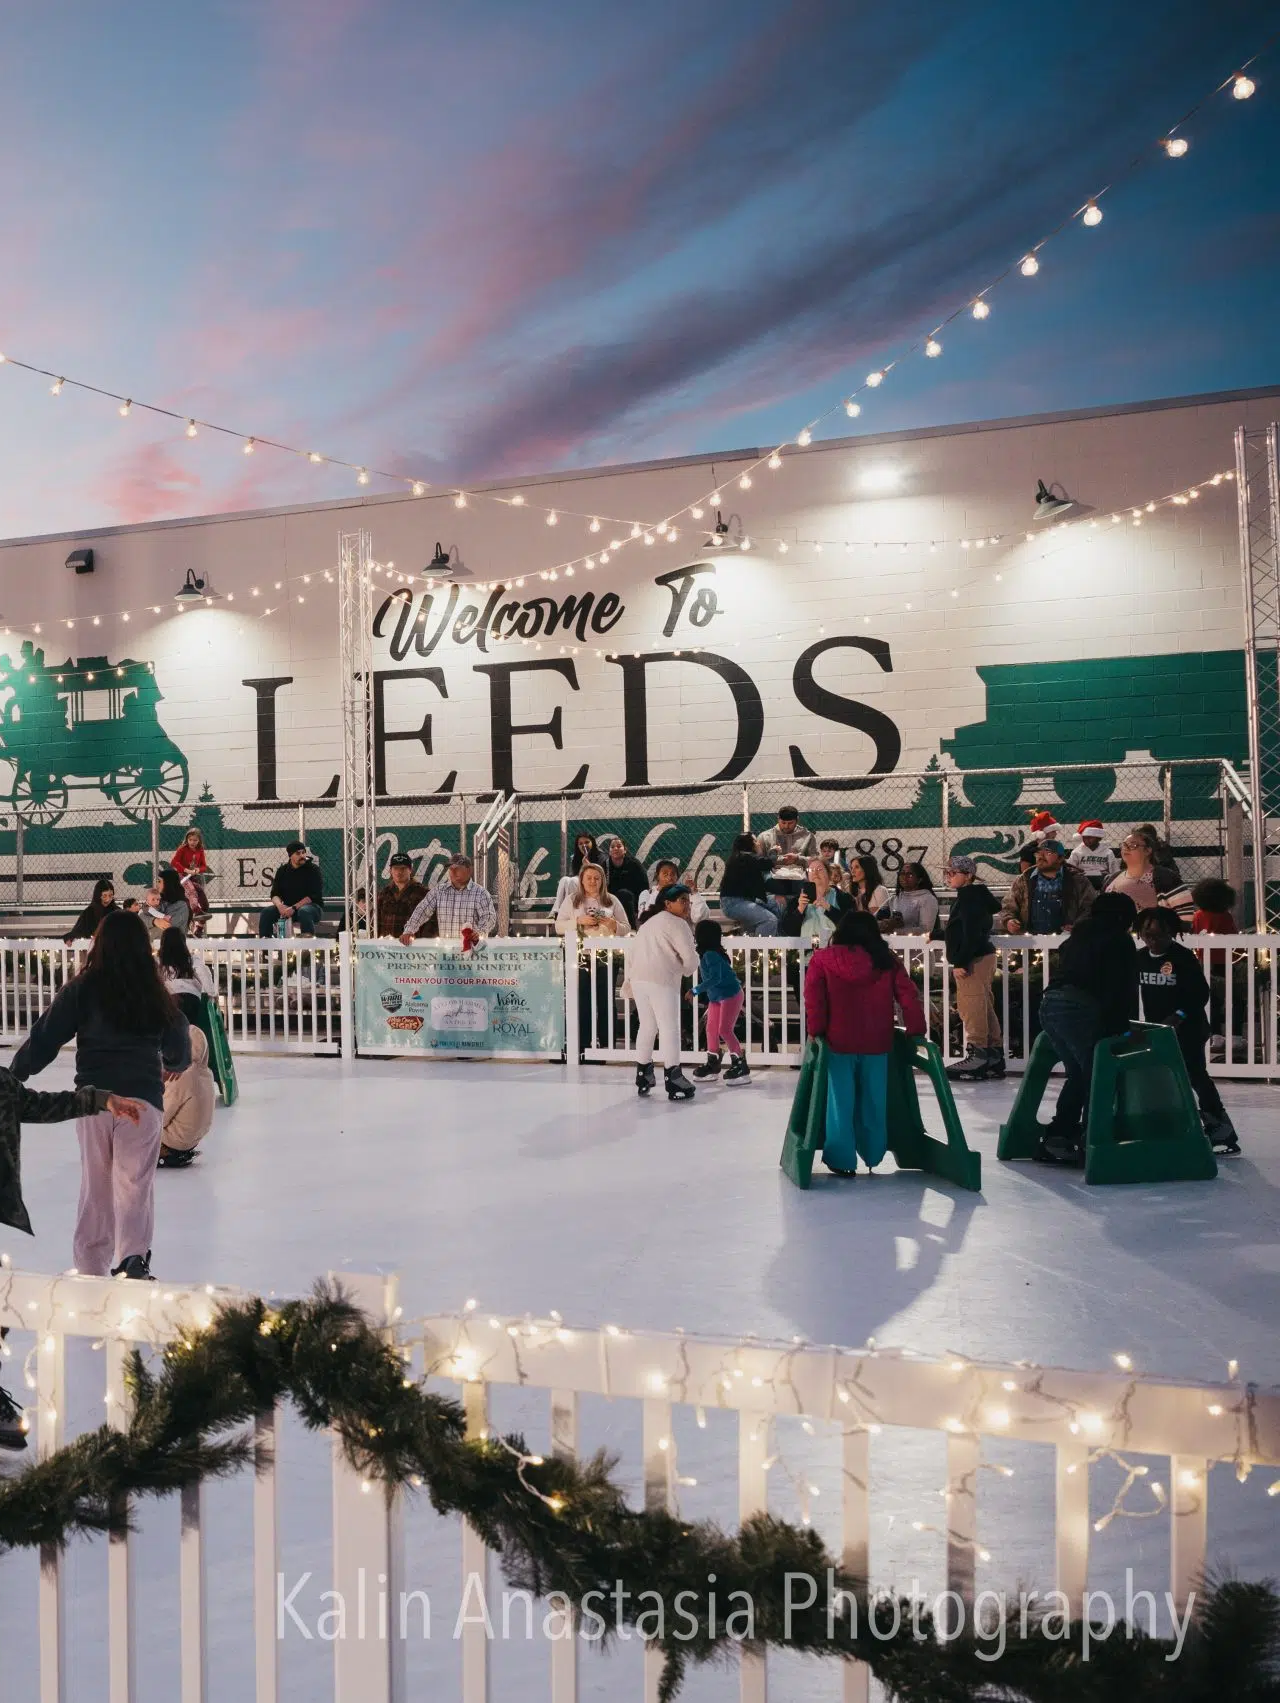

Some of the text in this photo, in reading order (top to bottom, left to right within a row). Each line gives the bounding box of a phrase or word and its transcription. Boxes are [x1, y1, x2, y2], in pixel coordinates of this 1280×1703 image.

[372, 562, 725, 661] Welcome To
[242, 636, 902, 811] LEEDS
[1080, 855, 1108, 863] LEEDS
[357, 951, 438, 962] DOWNTOWN
[494, 952, 519, 962] ICE
[523, 952, 562, 962] RINK
[387, 962, 526, 972] PRESENTED BY KINETIC
[395, 977, 518, 986] THANK YOU TO OUR PATRONS:
[1139, 971, 1177, 986] LEEDS
[493, 1023, 535, 1034] ROYAL
